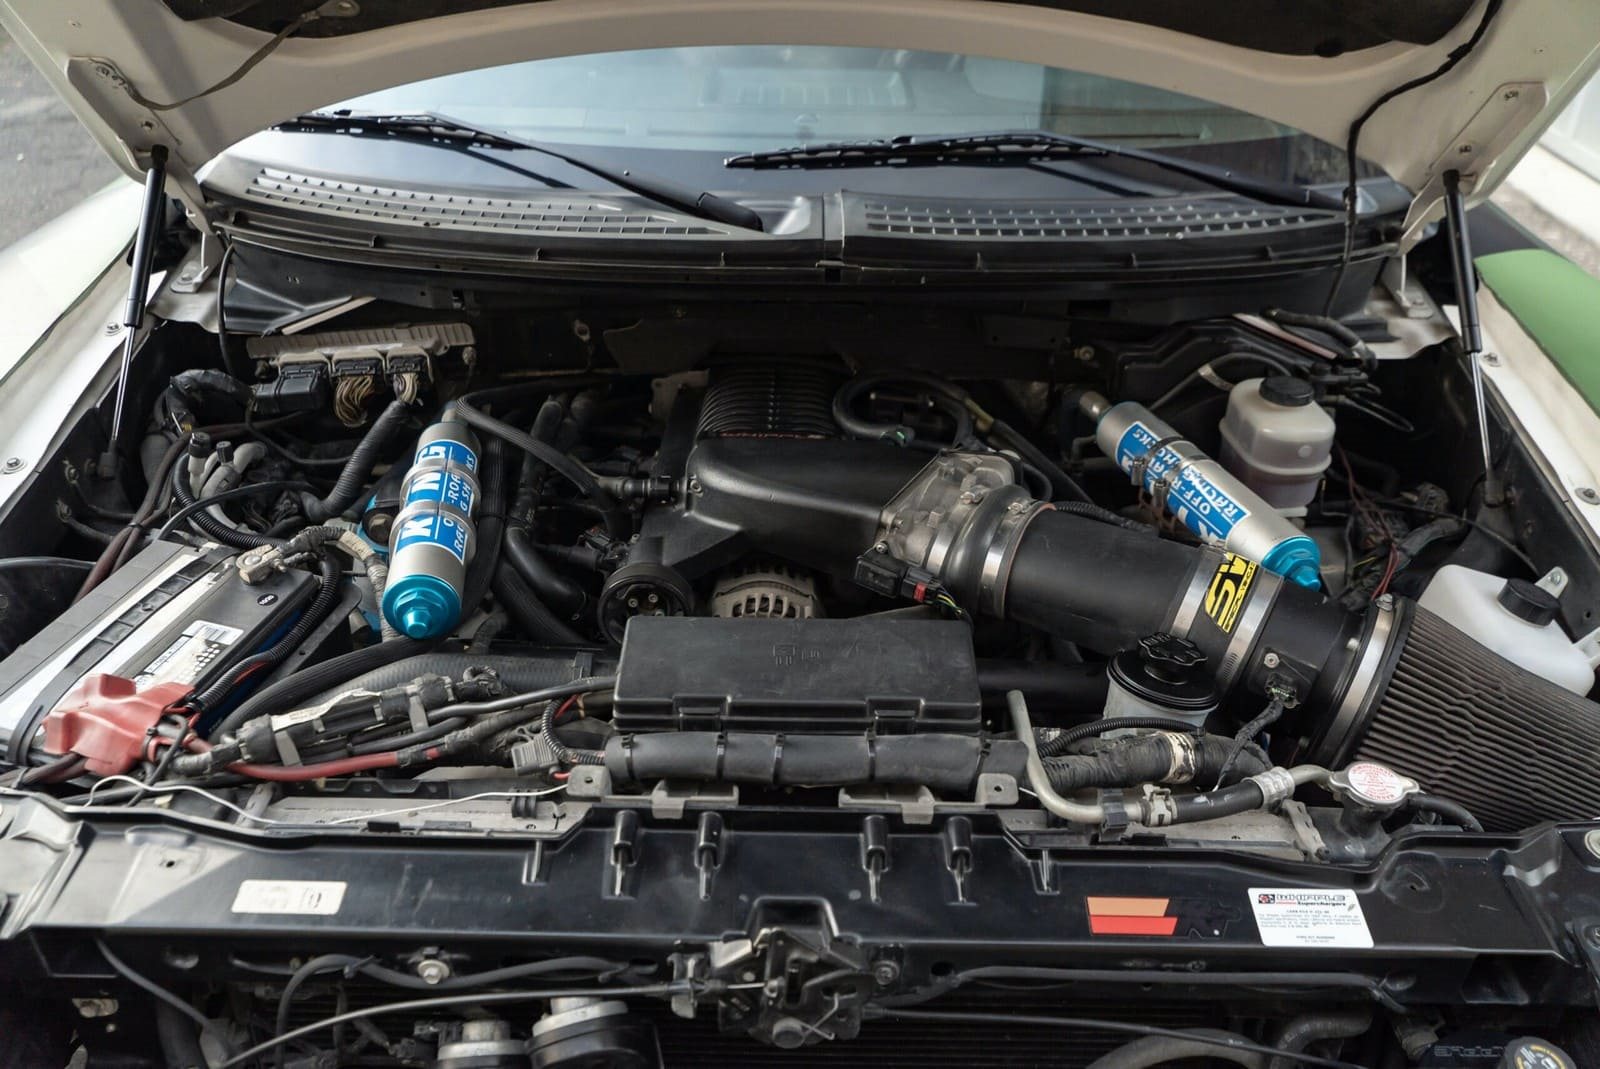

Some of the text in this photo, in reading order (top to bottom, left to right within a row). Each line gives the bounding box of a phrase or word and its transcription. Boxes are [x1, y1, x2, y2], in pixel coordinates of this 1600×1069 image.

[400, 445, 447, 540] KNG
[442, 472, 461, 528] O-ROA
[461, 454, 476, 496] SHKS
[1120, 454, 1224, 545] KIG
[1276, 893, 1345, 902] WHIPPLE
